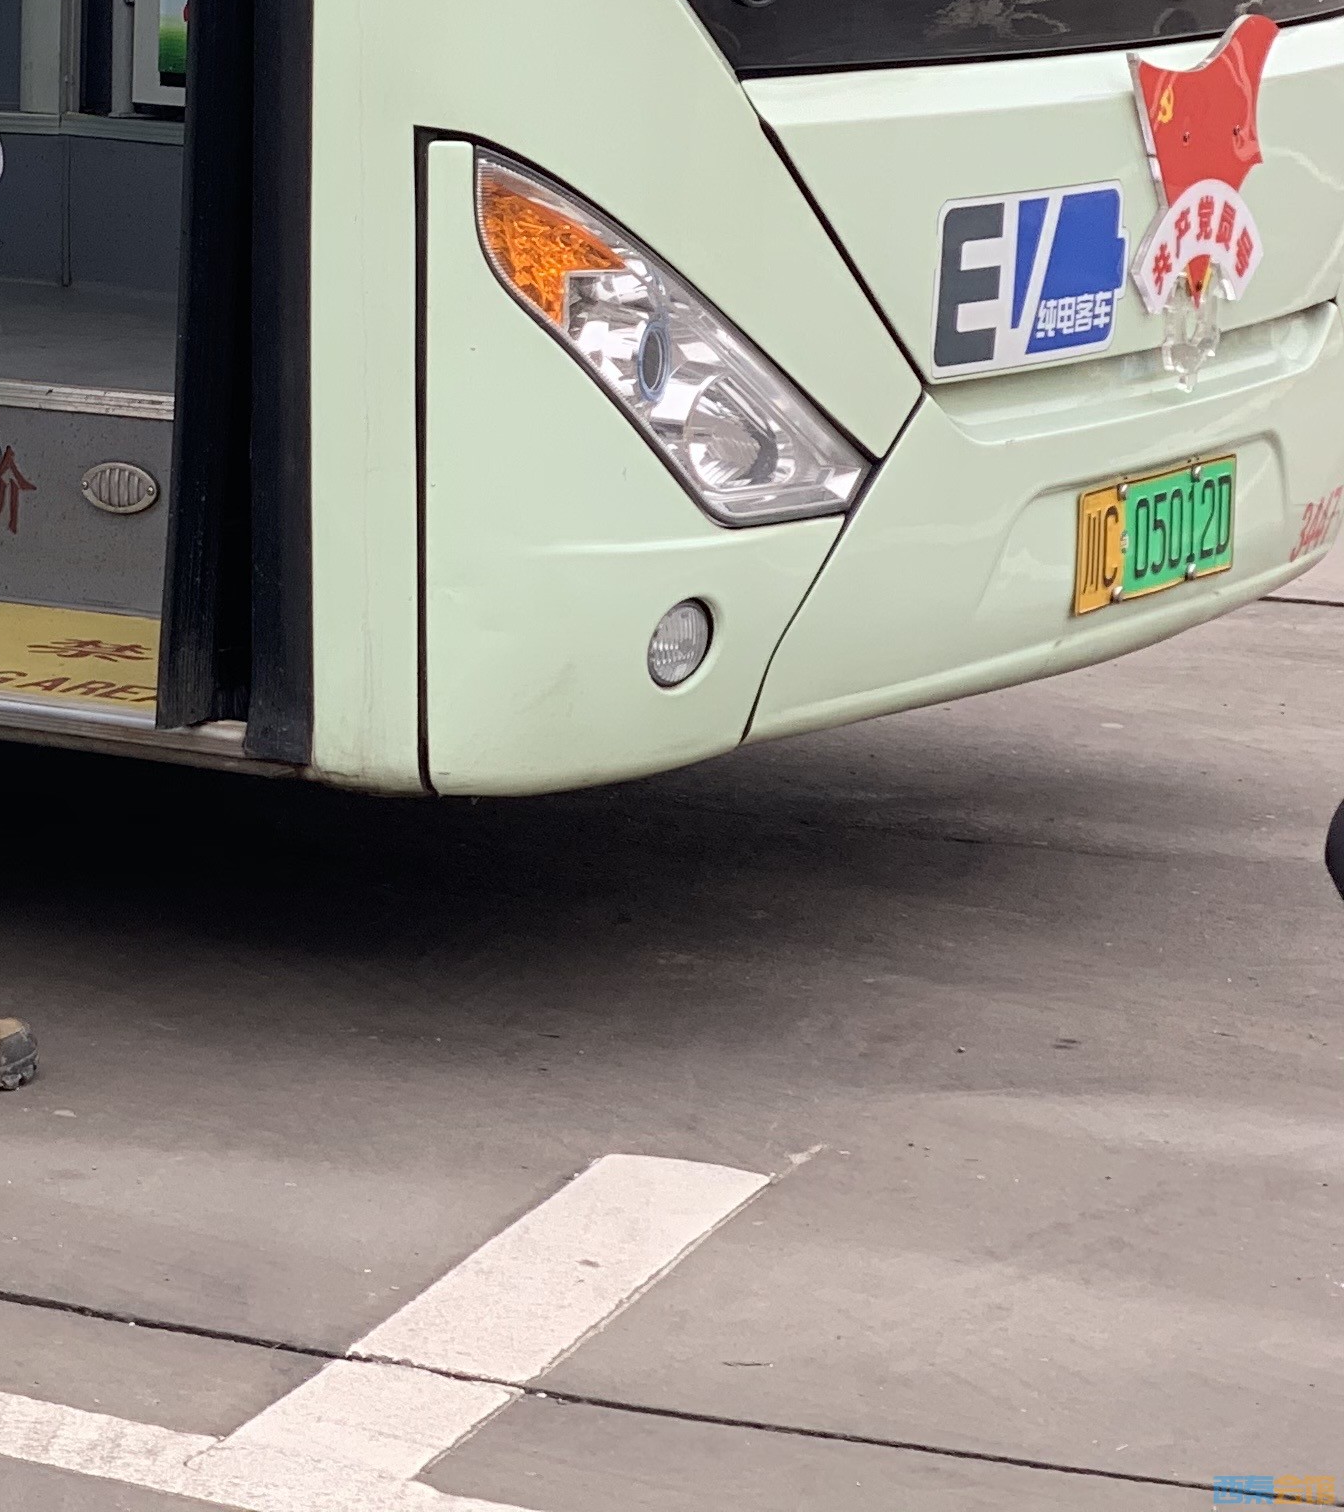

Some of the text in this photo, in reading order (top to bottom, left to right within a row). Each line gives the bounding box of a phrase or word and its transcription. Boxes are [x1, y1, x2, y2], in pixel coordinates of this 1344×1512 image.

[1151, 194, 1255, 296] 共产党员号
[1034, 291, 1112, 339] 纯电客车
